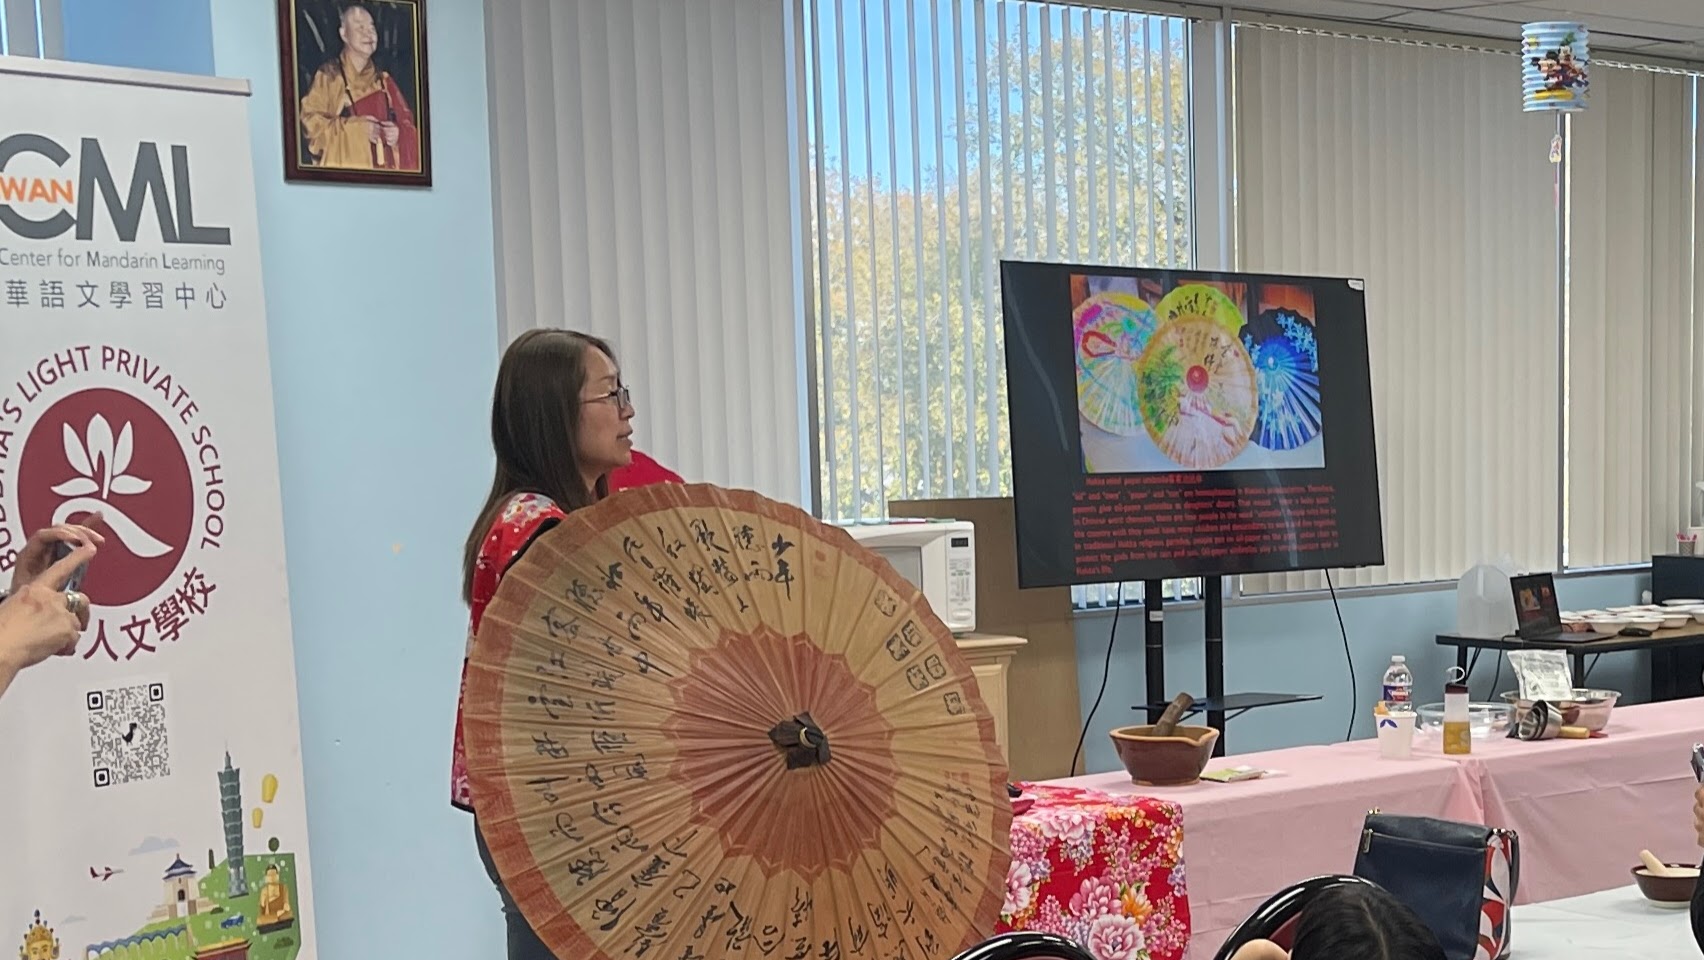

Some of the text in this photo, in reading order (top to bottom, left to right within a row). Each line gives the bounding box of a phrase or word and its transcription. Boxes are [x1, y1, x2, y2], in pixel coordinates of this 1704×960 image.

[0, 248, 225, 276] Center for Mandarin Learning
[5, 279, 227, 310] 華語文學習中心
[17, 345, 90, 403] LIGHT
[101, 345, 199, 425] PRIVATE
[191, 425, 226, 550] SCHOOL
[82, 566, 217, 662] 人文學校
